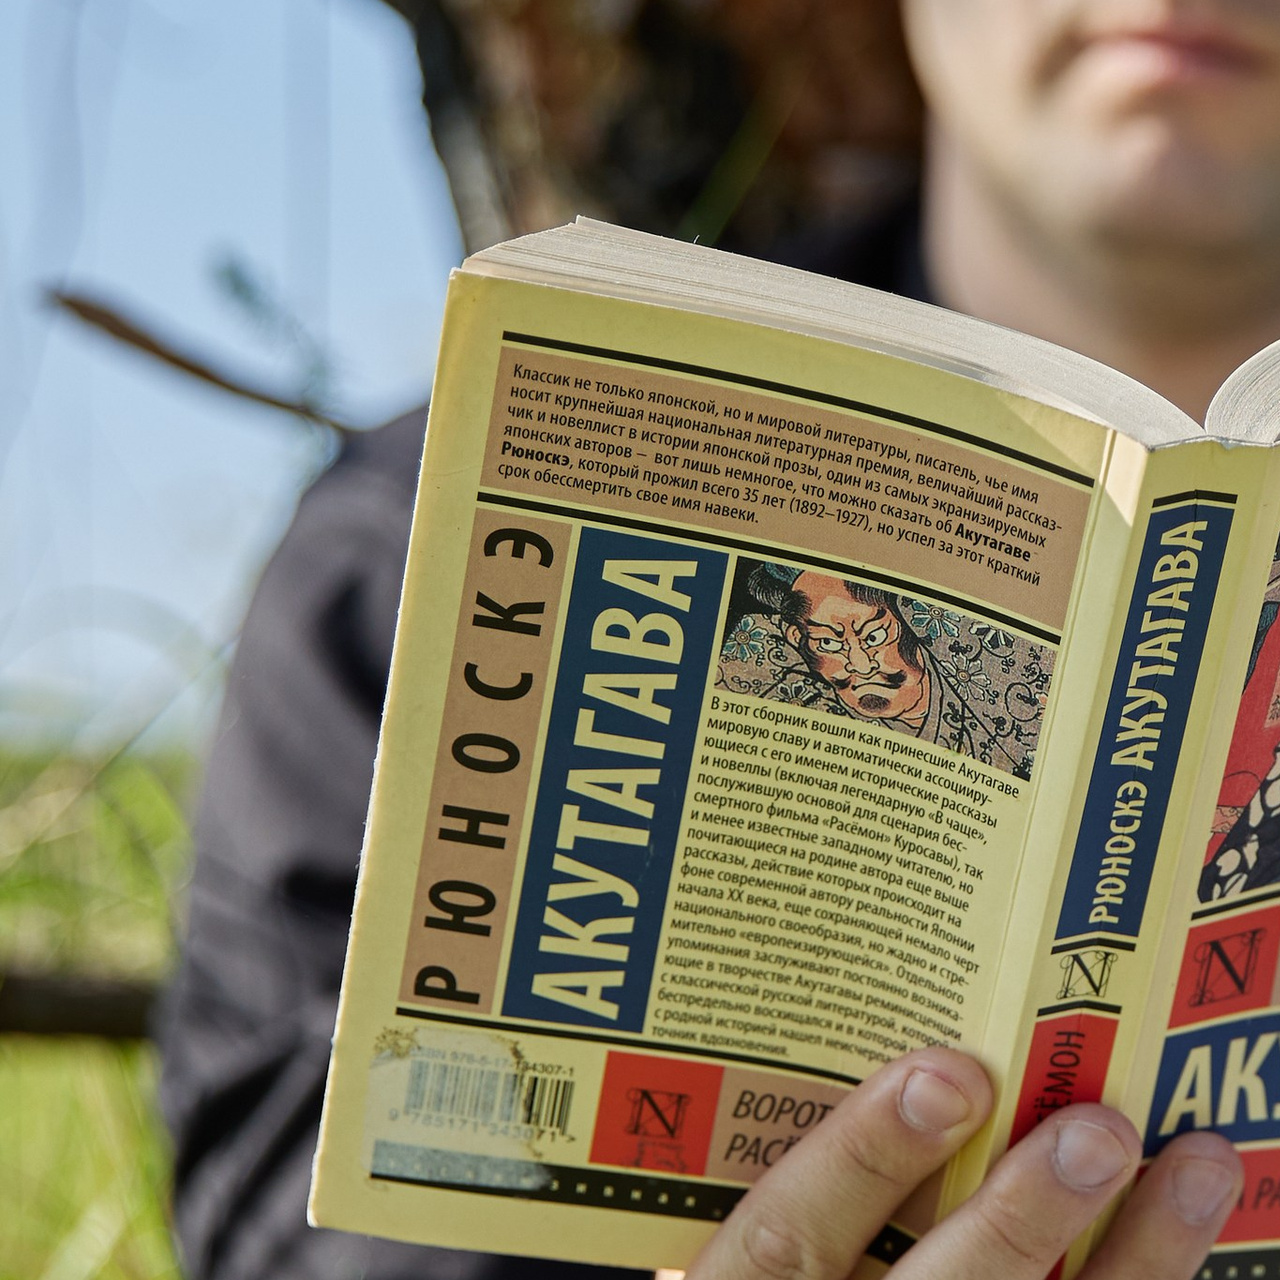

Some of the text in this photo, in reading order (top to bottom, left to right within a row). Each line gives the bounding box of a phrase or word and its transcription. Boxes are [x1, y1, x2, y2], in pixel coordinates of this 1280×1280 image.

[507, 404, 1047, 548] чик и новеллист в истории японской прозы, один из самых экранизируемых
[509, 385, 1062, 531] носит крупнейшая национальная литературная премия, величайший рассказ-
[512, 362, 1039, 504] Классик не только японской, но и мировой литературы, писатель, чье имя
[497, 463, 758, 523] срок обессмертить свое имя навеки.
[500, 440, 573, 470] Рюноскэ,
[577, 457, 639, 480] который
[642, 469, 698, 491] прожил
[701, 480, 740, 499] всего
[741, 486, 760, 503] 35
[760, 493, 787, 509] лет
[876, 521, 894, 536] но
[895, 526, 936, 549] успел
[937, 539, 953, 554] за
[955, 545, 985, 564] этот
[986, 556, 1040, 586] краткий
[502, 424, 1031, 562] японских авторов вот лишь немногое, что можно сказать об Акутагаве
[414, 527, 554, 1005] РЮНОСКЭ
[706, 717, 992, 807] мировую славу и автоматически ассоцииру-
[709, 695, 1019, 799] В этот сборник вошли как принесшие Акутагаве
[1088, 520, 1209, 925] РЮНОСКЭ АКУТАГАВА
[531, 558, 699, 1021] АКУТАГАВА
[696, 772, 967, 852] послужившую основой для сценария бес-
[699, 753, 709, 766] и
[711, 756, 772, 778] новеллы
[839, 783, 926, 818] легендарную
[703, 735, 997, 828] ющиеся с его именем исторические рассказы
[686, 827, 969, 912] почитающиеся на родине автора еще выше
[689, 809, 974, 895] и менее известные западному читателю, но
[692, 790, 764, 814] смертного
[765, 801, 819, 825] фильма
[963, 862, 984, 880] так
[676, 881, 980, 974] начала XX века, еще сохраняющей немало черт
[679, 861, 975, 953] фоне современной автору реальности Японии
[682, 845, 962, 928] рассказы, действие которых происходит на
[669, 917, 737, 939] мительно
[895, 964, 964, 1005] Отдельного
[672, 899, 969, 987] национального своеобразия, но жадно и стре-
[731, 1089, 837, 1130] ВОРОТ
[1033, 1030, 1085, 1122] ЁМОН
[723, 1132, 802, 1167] РАС
